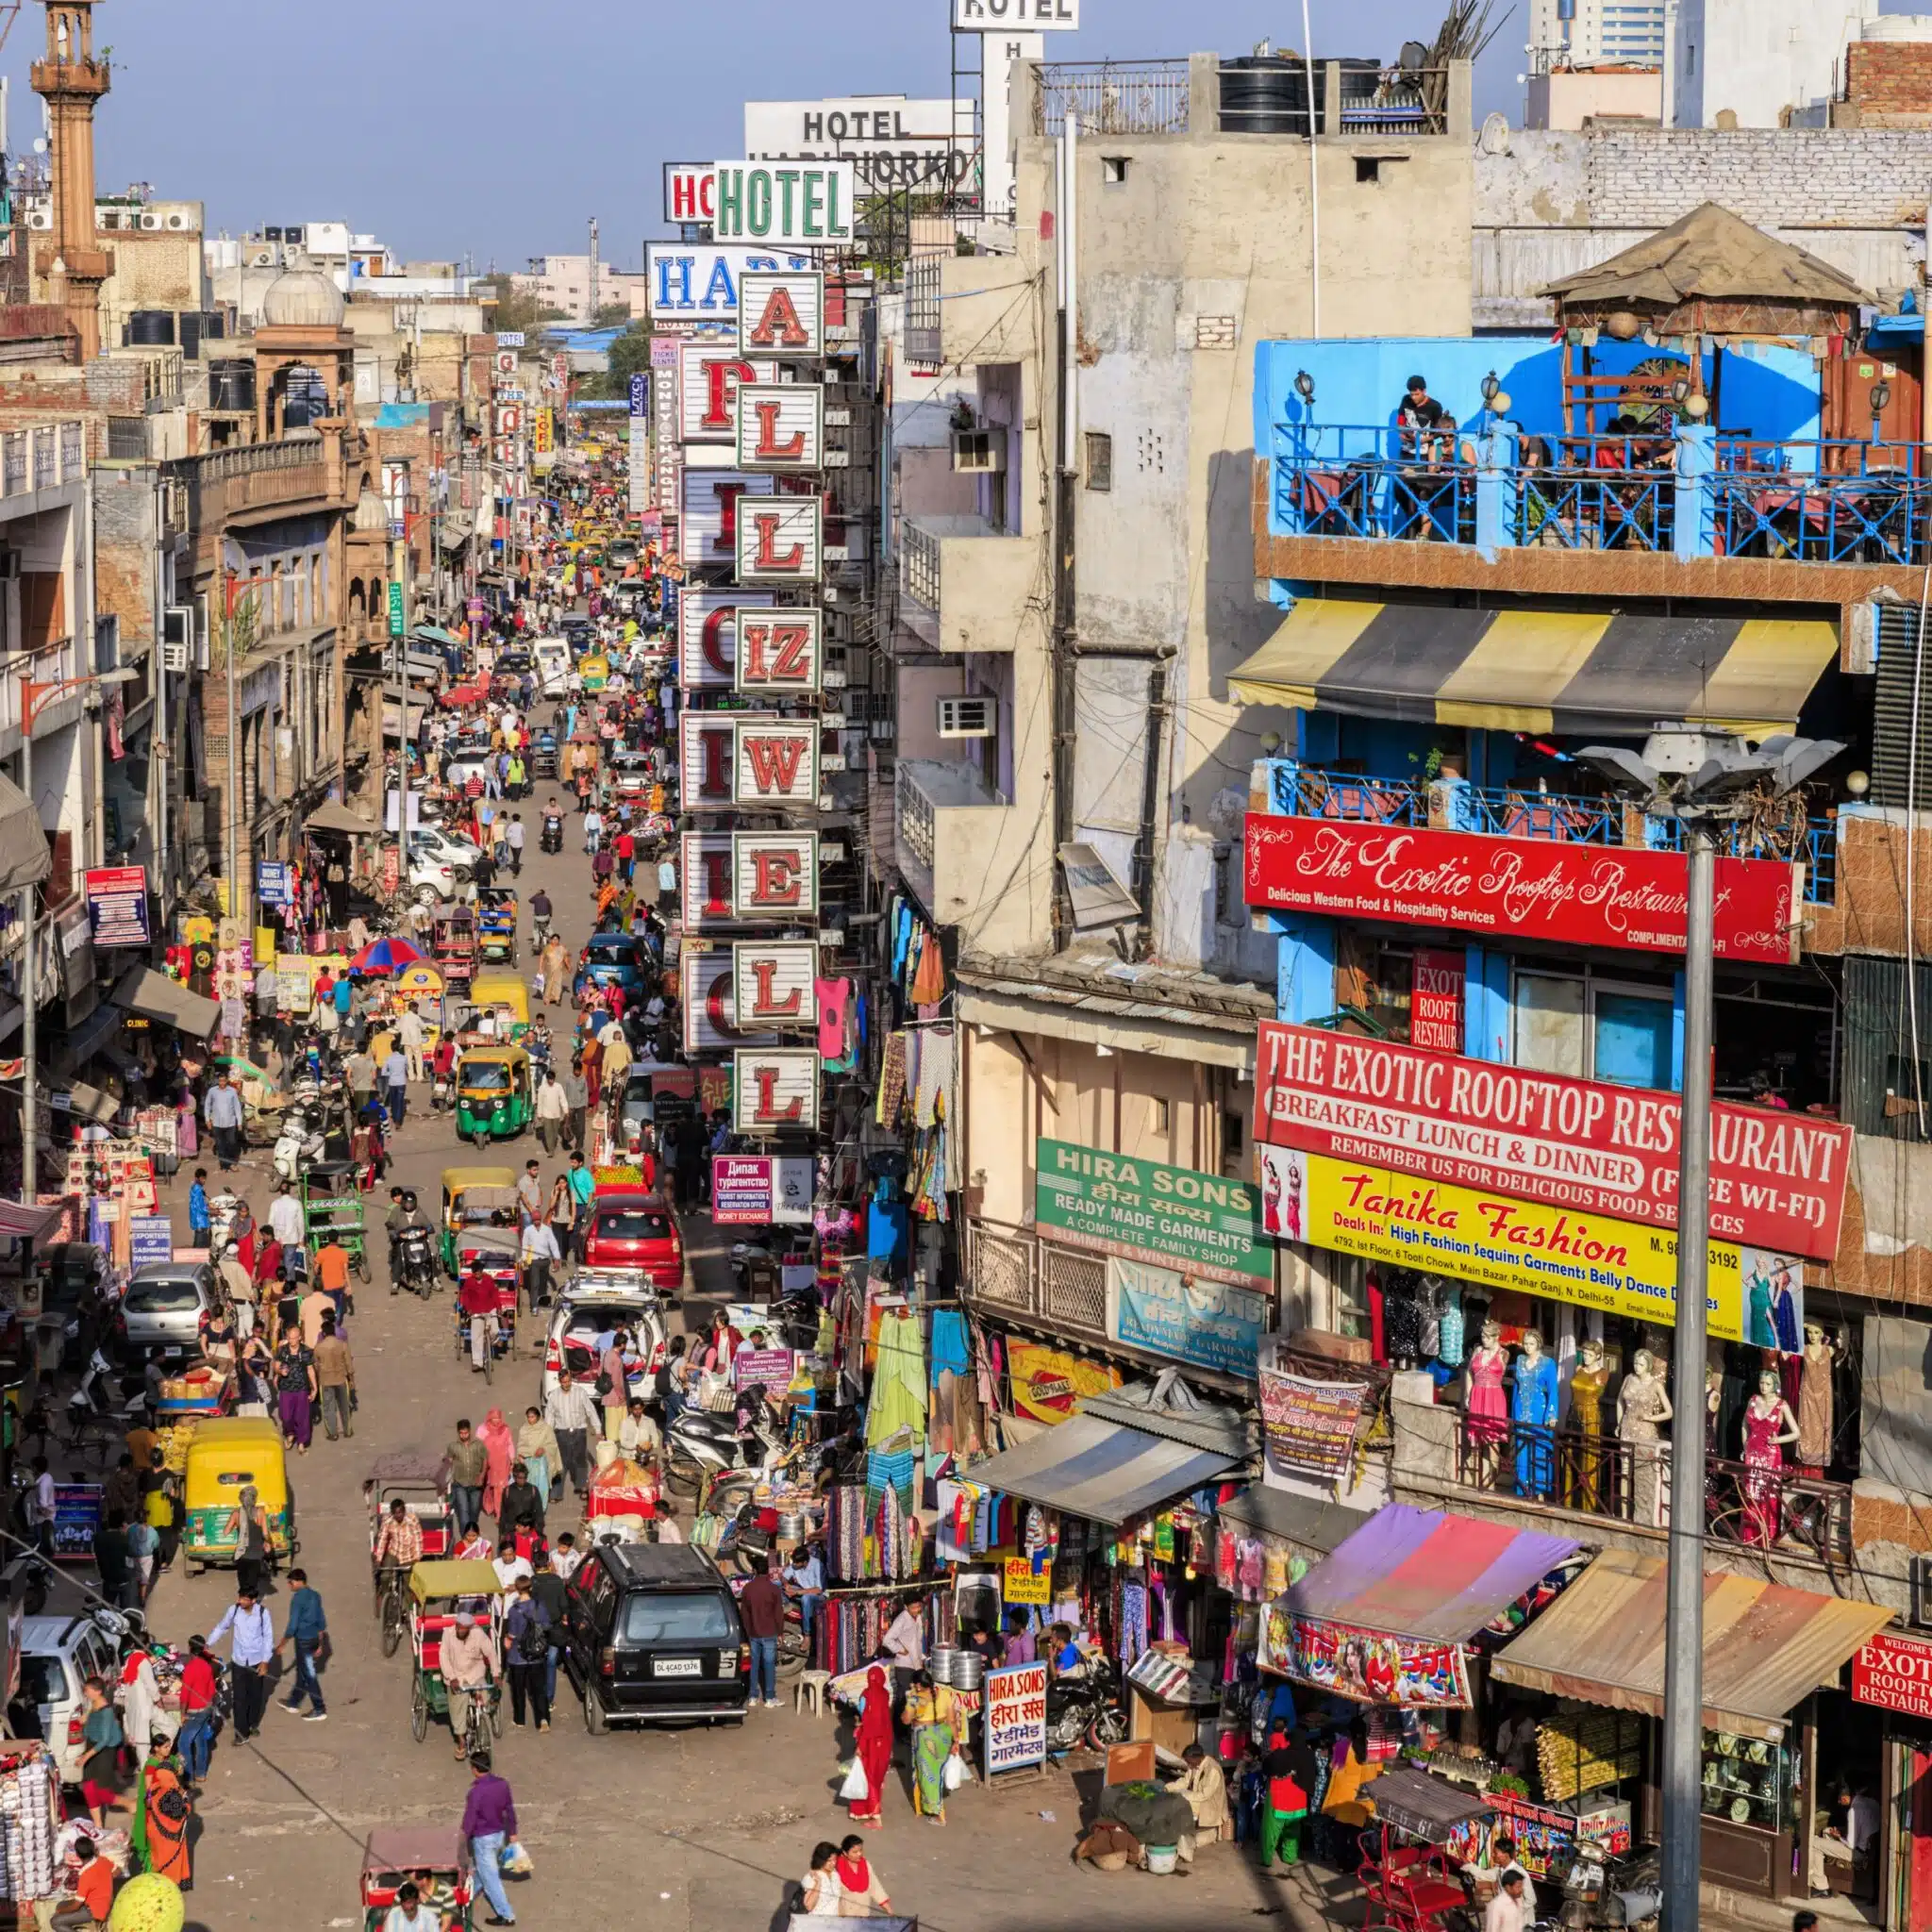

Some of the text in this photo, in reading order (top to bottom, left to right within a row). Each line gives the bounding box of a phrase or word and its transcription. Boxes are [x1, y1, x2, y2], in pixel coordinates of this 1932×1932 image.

[804, 110, 910, 142] HOTEL
[720, 169, 848, 237] HOTEL
[1296, 827, 1356, 877] The
[1358, 834, 1472, 896] Exotic
[1268, 887, 1495, 924] Delicious Western Food & Hospitality Services
[1627, 930, 1688, 948] COMPLIMENTA
[1417, 953, 1429, 965] THE
[127, 1020, 149, 1028] CLINIC
[1266, 1030, 1841, 1184] THE EXOTIC ROOFTOP RESURANT
[727, 1161, 758, 1176] Дипак
[1273, 1091, 1410, 1140] BREAKFAST
[1416, 1121, 1499, 1158] LUNCH
[1506, 1141, 1527, 1163] &
[1533, 1145, 1637, 1186] DINNER
[1740, 1183, 1826, 1227] WI-FI)
[718, 1177, 769, 1190] турагентство
[1057, 1148, 1252, 1211] HIRA SONS
[1091, 1182, 1142, 1208] हीरा
[1331, 1135, 1744, 1235] REMEMBER US FOR DELICIOUS FOOD SECES
[1055, 1193, 1252, 1254] READY MADE GARMENTS
[1341, 1174, 1627, 1267] Tanika Fashion
[1053, 1228, 1253, 1287] SUMMER & WINTER WEAR
[1066, 1215, 1239, 1267] A COMPLETE FAMILY SHOP
[1333, 1212, 1365, 1231] Deals
[1368, 1219, 1384, 1236] In:
[1390, 1224, 1420, 1246] High
[1423, 1229, 1470, 1255] Fashion
[1474, 1242, 1520, 1267] Sequins
[1524, 1254, 1586, 1280] Garments
[1590, 1268, 1622, 1291] Belly
[1626, 1276, 1667, 1299] Dance
[1650, 1237, 1663, 1253] M.
[1370, 1242, 1393, 1258] Floor,
[1395, 1248, 1401, 1258] 6
[1402, 1249, 1424, 1264] Tooti
[1459, 1264, 1480, 1276] Main
[1483, 1268, 1509, 1283] Bazar,
[1511, 1274, 1538, 1289] Pahar
[1540, 1280, 1563, 1296] Ganj,
[1566, 1287, 1575, 1298] N.
[1578, 1289, 1615, 1307] Delhi-55
[1884, 1638, 1926, 1655] WELCOME
[990, 1674, 1015, 1702] HIRA
[1017, 1669, 1045, 1696] SONS
[991, 1701, 1019, 1729] हीरा
[1022, 1697, 1045, 1721] संस
[991, 1724, 1040, 1744] रेडीमेड
